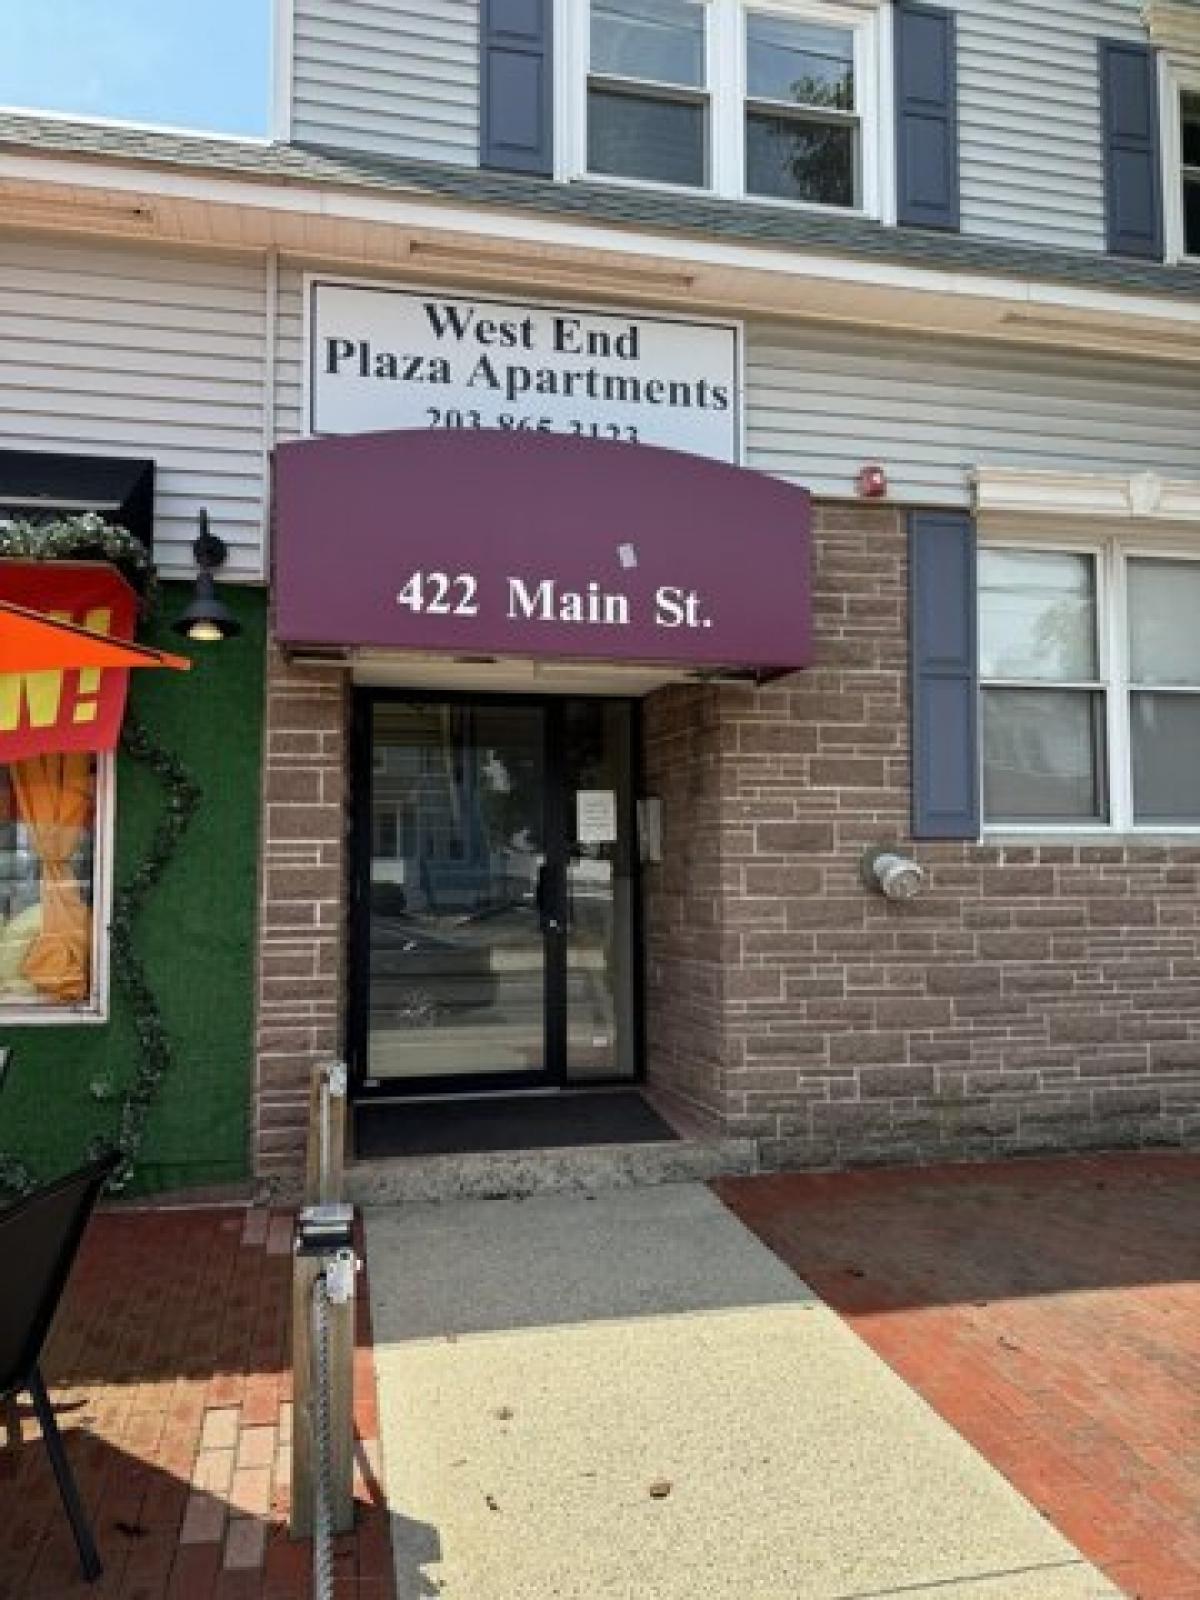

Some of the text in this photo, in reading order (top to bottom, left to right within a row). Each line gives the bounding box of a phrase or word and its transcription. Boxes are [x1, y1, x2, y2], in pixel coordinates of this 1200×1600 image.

[424, 303, 640, 361] West End
[325, 335, 729, 411] Plaza Apartments
[397, 570, 713, 628] 422 Main St.
